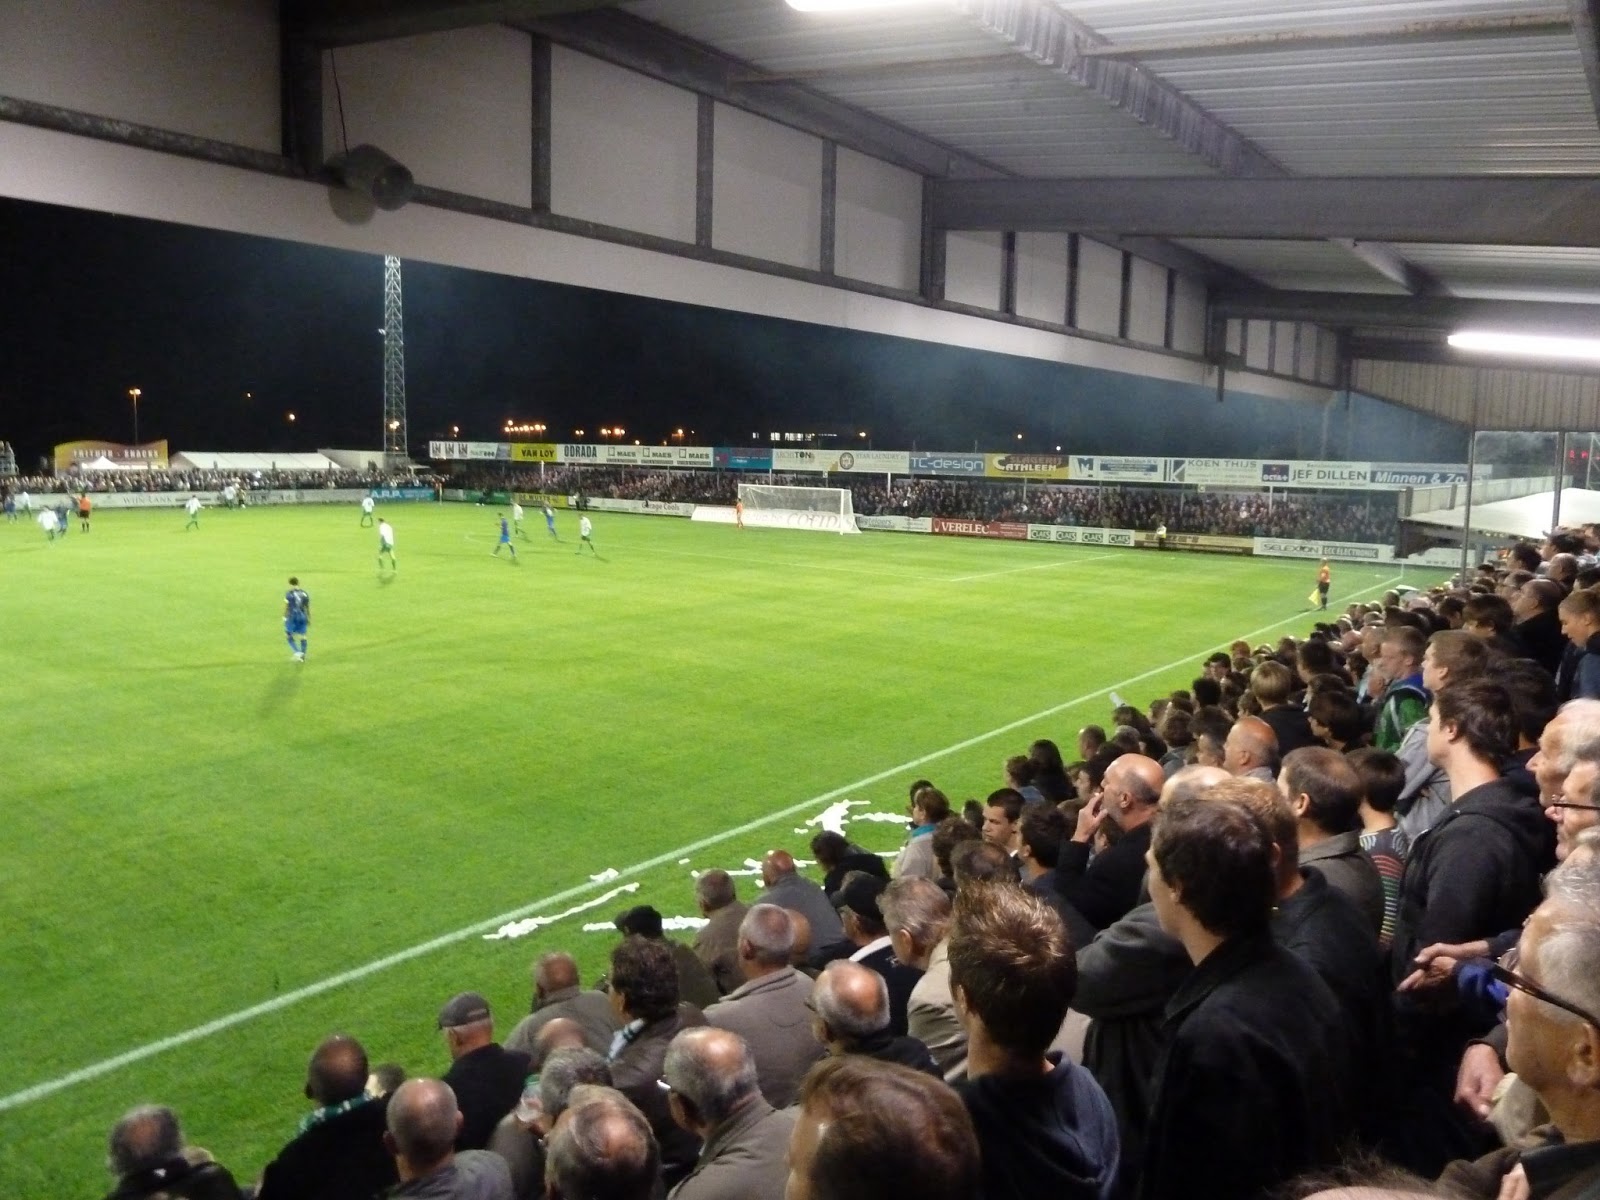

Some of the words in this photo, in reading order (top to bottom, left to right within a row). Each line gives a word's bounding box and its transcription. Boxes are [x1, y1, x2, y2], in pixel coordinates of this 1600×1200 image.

[521, 449, 537, 457] VAN
[539, 450, 555, 458] LOY
[911, 457, 984, 471] TC-design
[1187, 460, 1220, 468] KOEN
[1224, 460, 1257, 468] THIJS
[1291, 469, 1313, 481] JEF
[1317, 470, 1367, 480] DILLEN
[1374, 471, 1426, 484] Minnen
[1430, 473, 1440, 484] &
[641, 502, 662, 511] Grage
[941, 521, 990, 535] VERELEC
[1031, 530, 1051, 539] CLAES
[1056, 532, 1077, 541] CLAES
[1082, 533, 1103, 542] CLAES
[1109, 535, 1130, 544] CLAES
[1263, 543, 1319, 553] SELEXION
